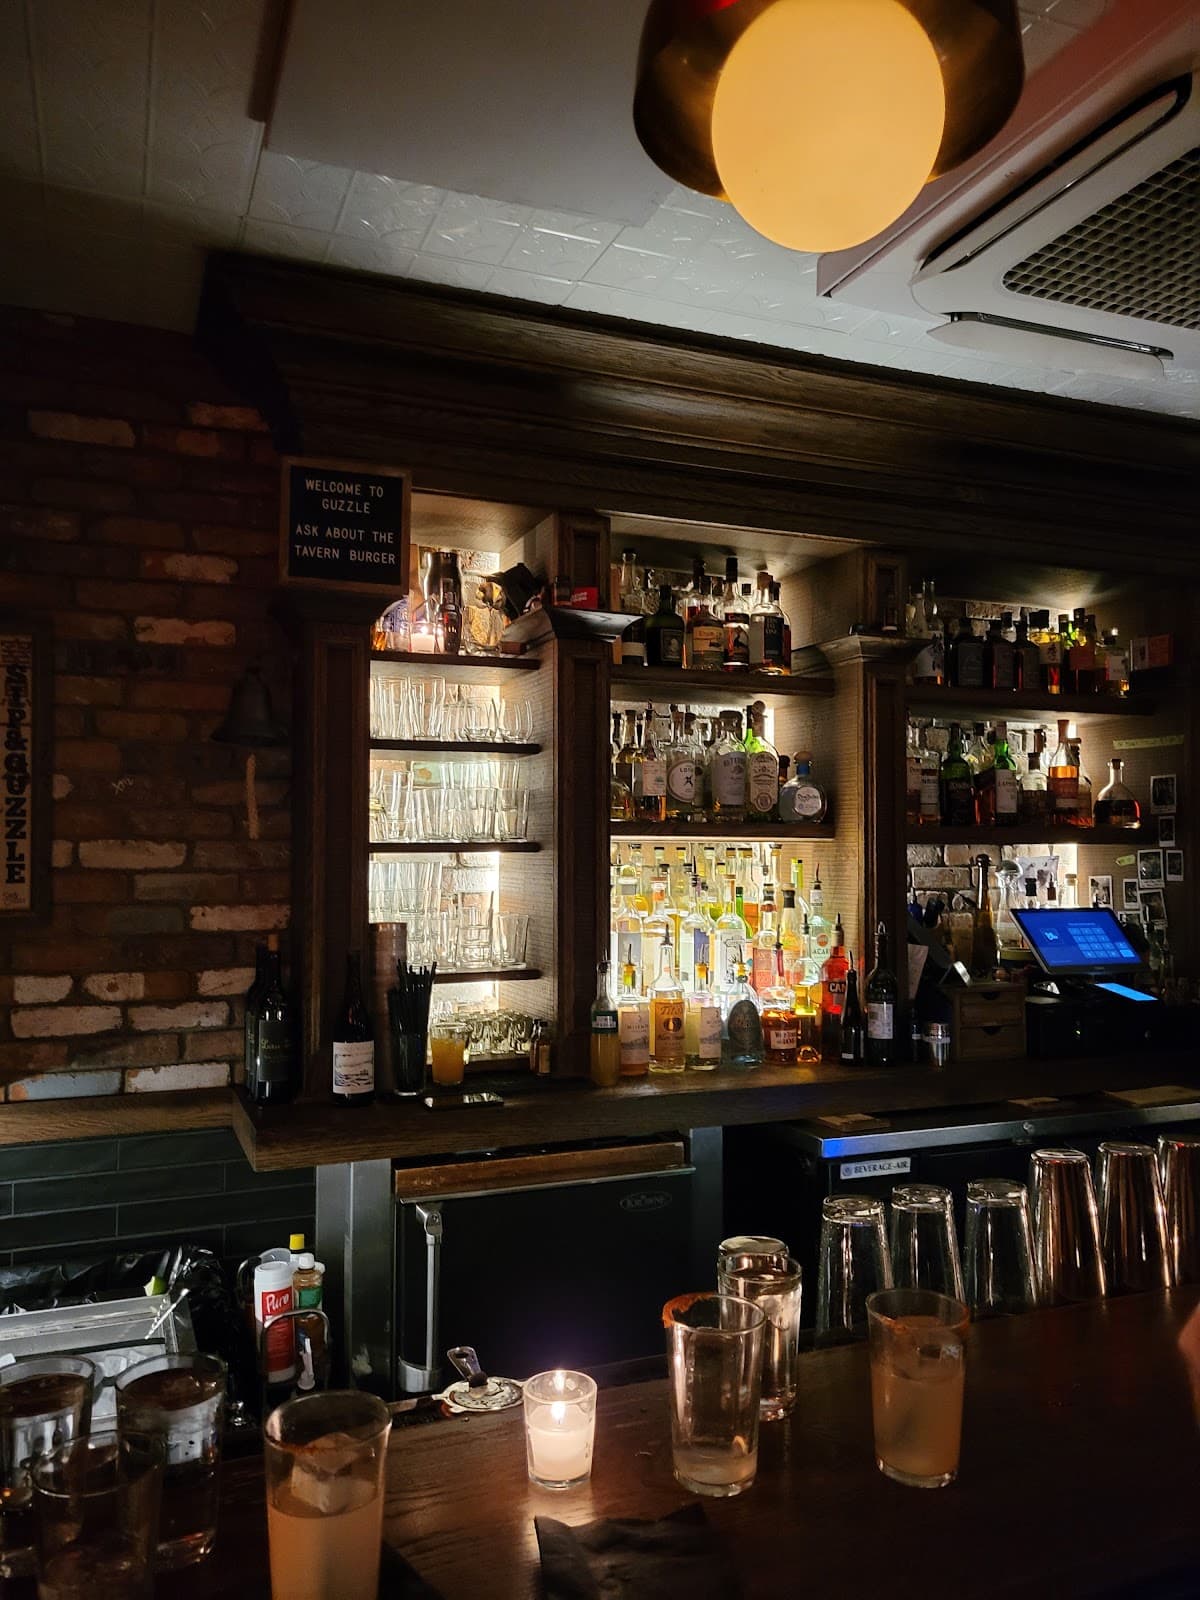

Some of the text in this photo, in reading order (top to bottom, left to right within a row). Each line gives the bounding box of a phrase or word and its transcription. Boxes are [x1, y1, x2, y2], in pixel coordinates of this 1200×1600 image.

[305, 480, 383, 498] WELCOME TO
[322, 499, 370, 514] GUZZLE
[296, 525, 394, 544] ASK ABOUT THE
[294, 546, 396, 565] TAVERN BURGER
